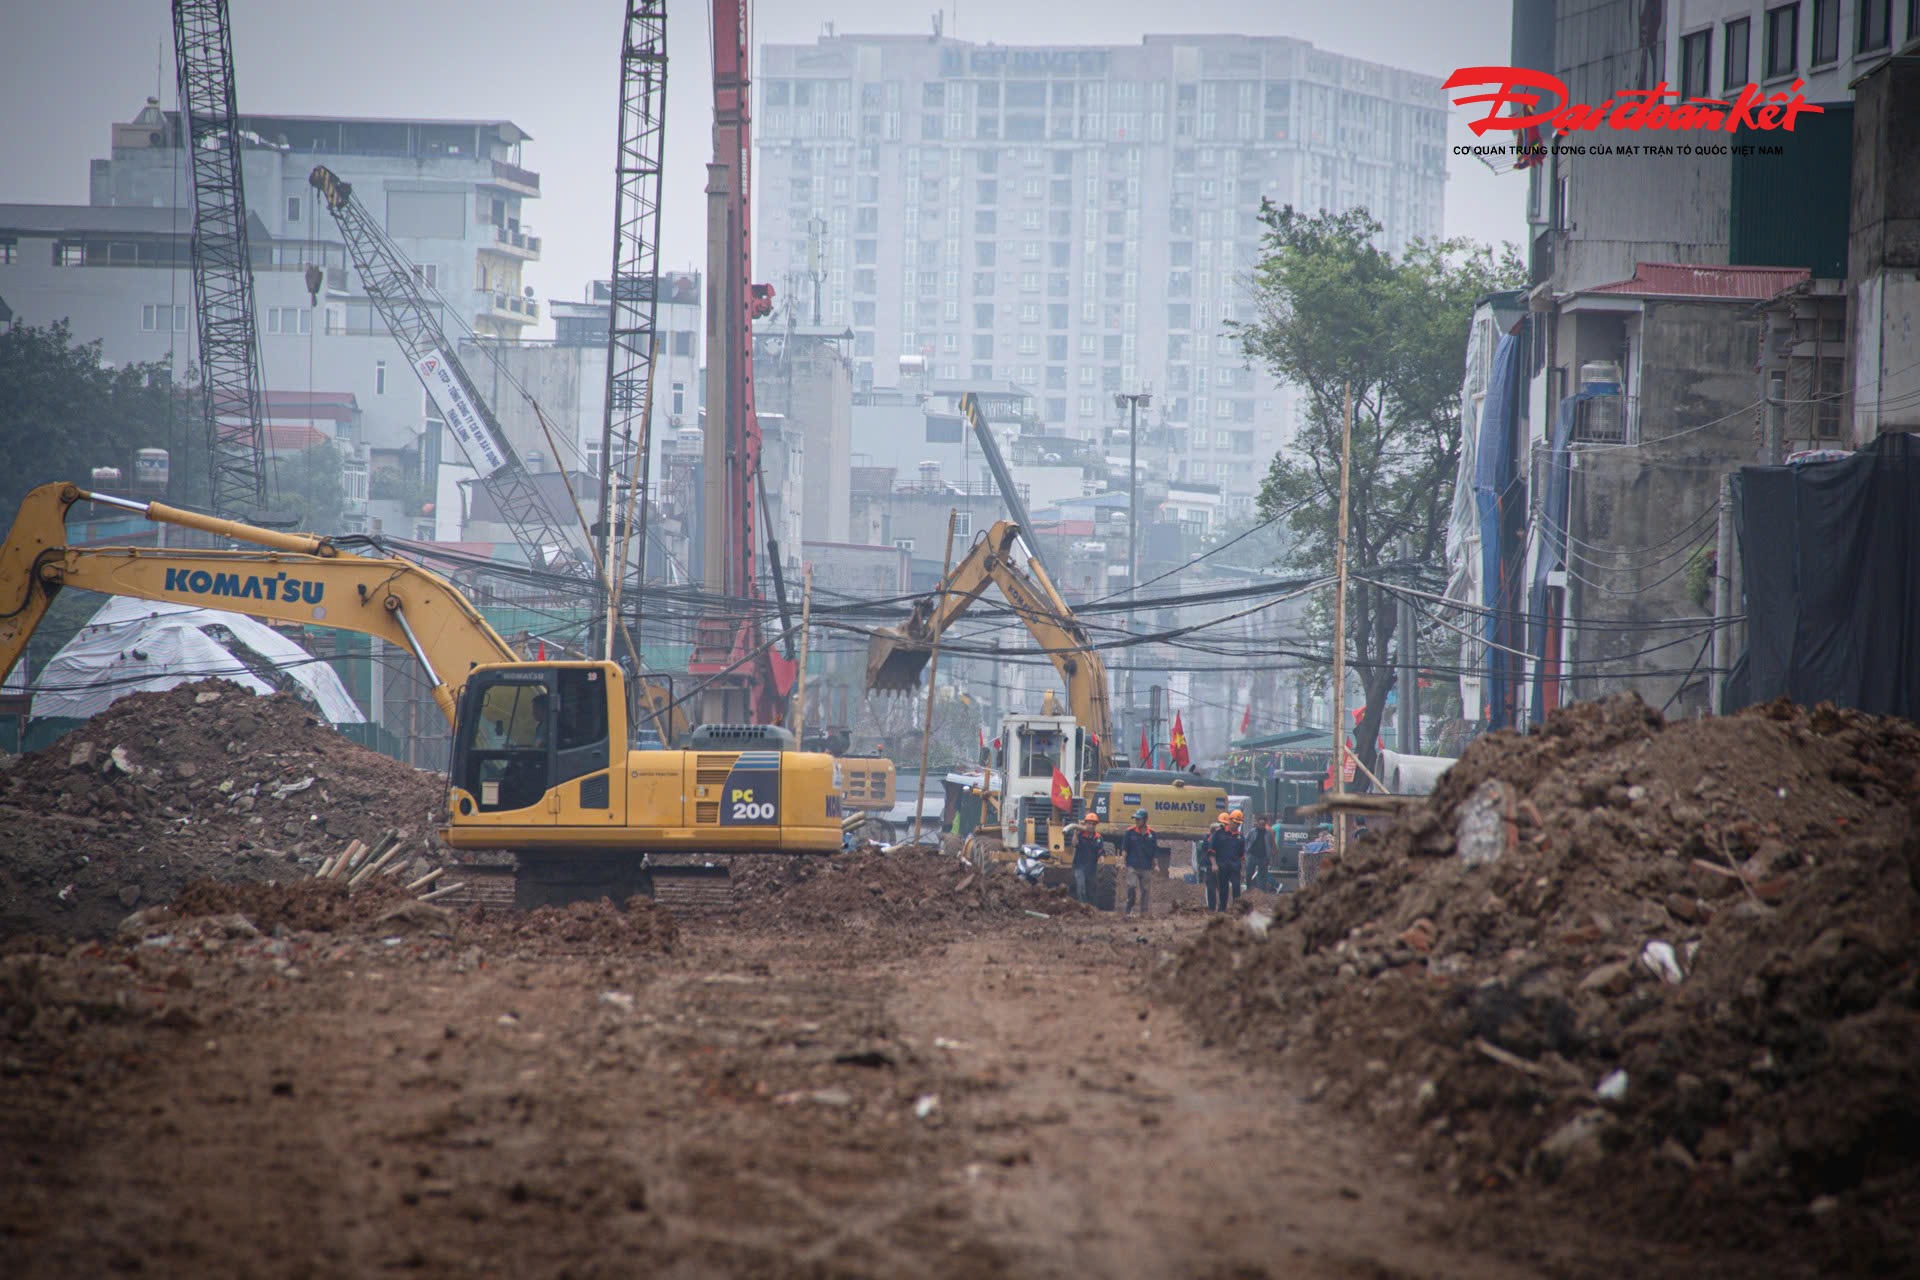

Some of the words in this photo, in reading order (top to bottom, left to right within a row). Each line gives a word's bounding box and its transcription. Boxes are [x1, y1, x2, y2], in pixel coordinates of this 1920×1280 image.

[164, 567, 324, 605] KOMATSU
[732, 789, 753, 803] PC
[732, 802, 775, 819] 200
[1155, 800, 1206, 813] KOMATSU
